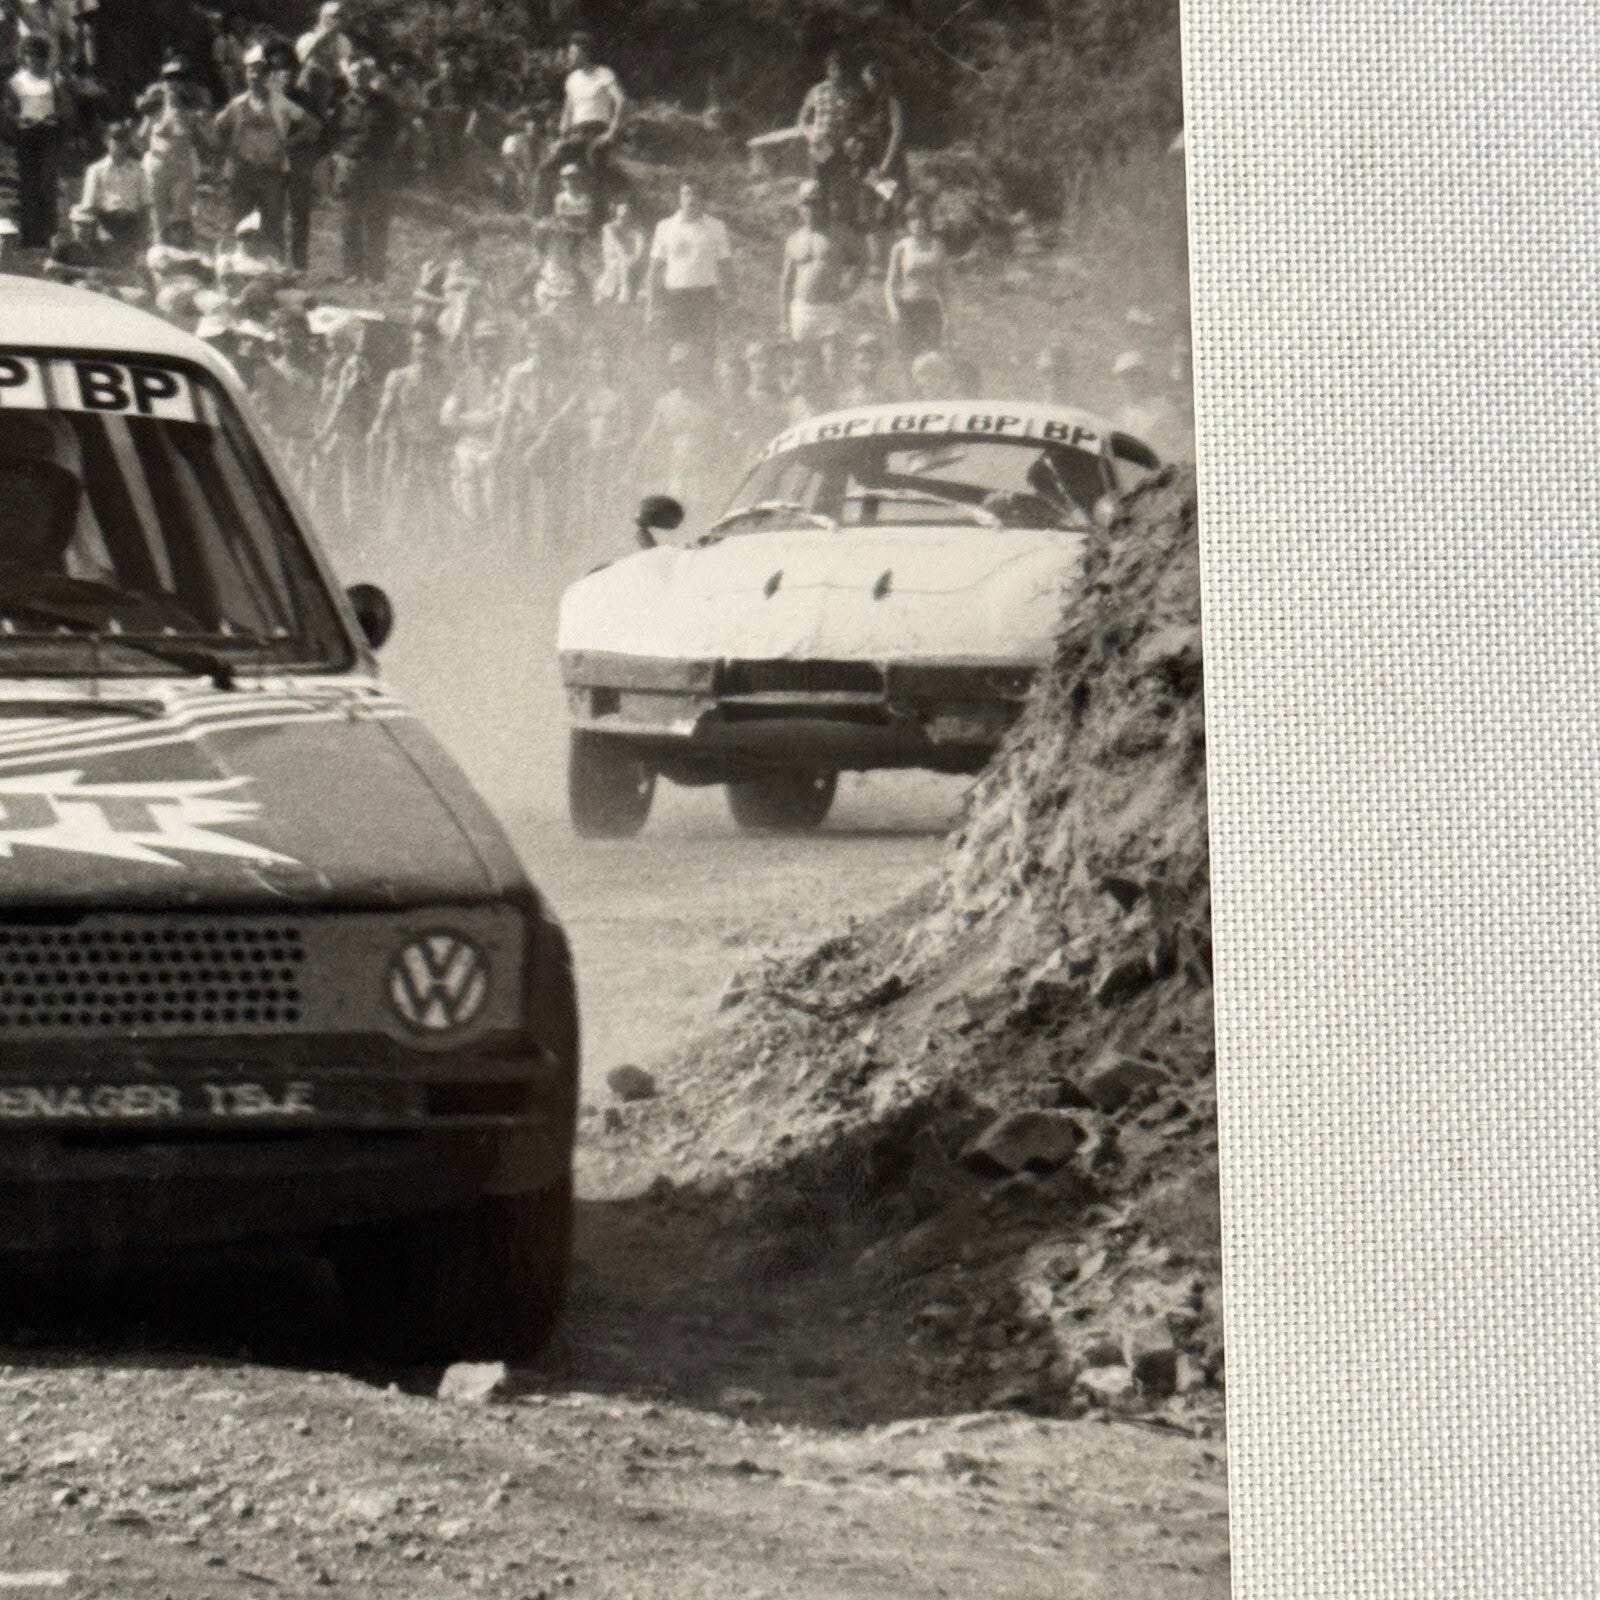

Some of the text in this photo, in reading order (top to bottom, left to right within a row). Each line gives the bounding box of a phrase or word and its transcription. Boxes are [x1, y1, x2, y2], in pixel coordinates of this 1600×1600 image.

[75, 361, 178, 414] BP
[891, 412, 945, 432] BP
[966, 413, 1022, 432] BP
[1043, 419, 1097, 446] BP
[384, 929, 490, 1031] VW
